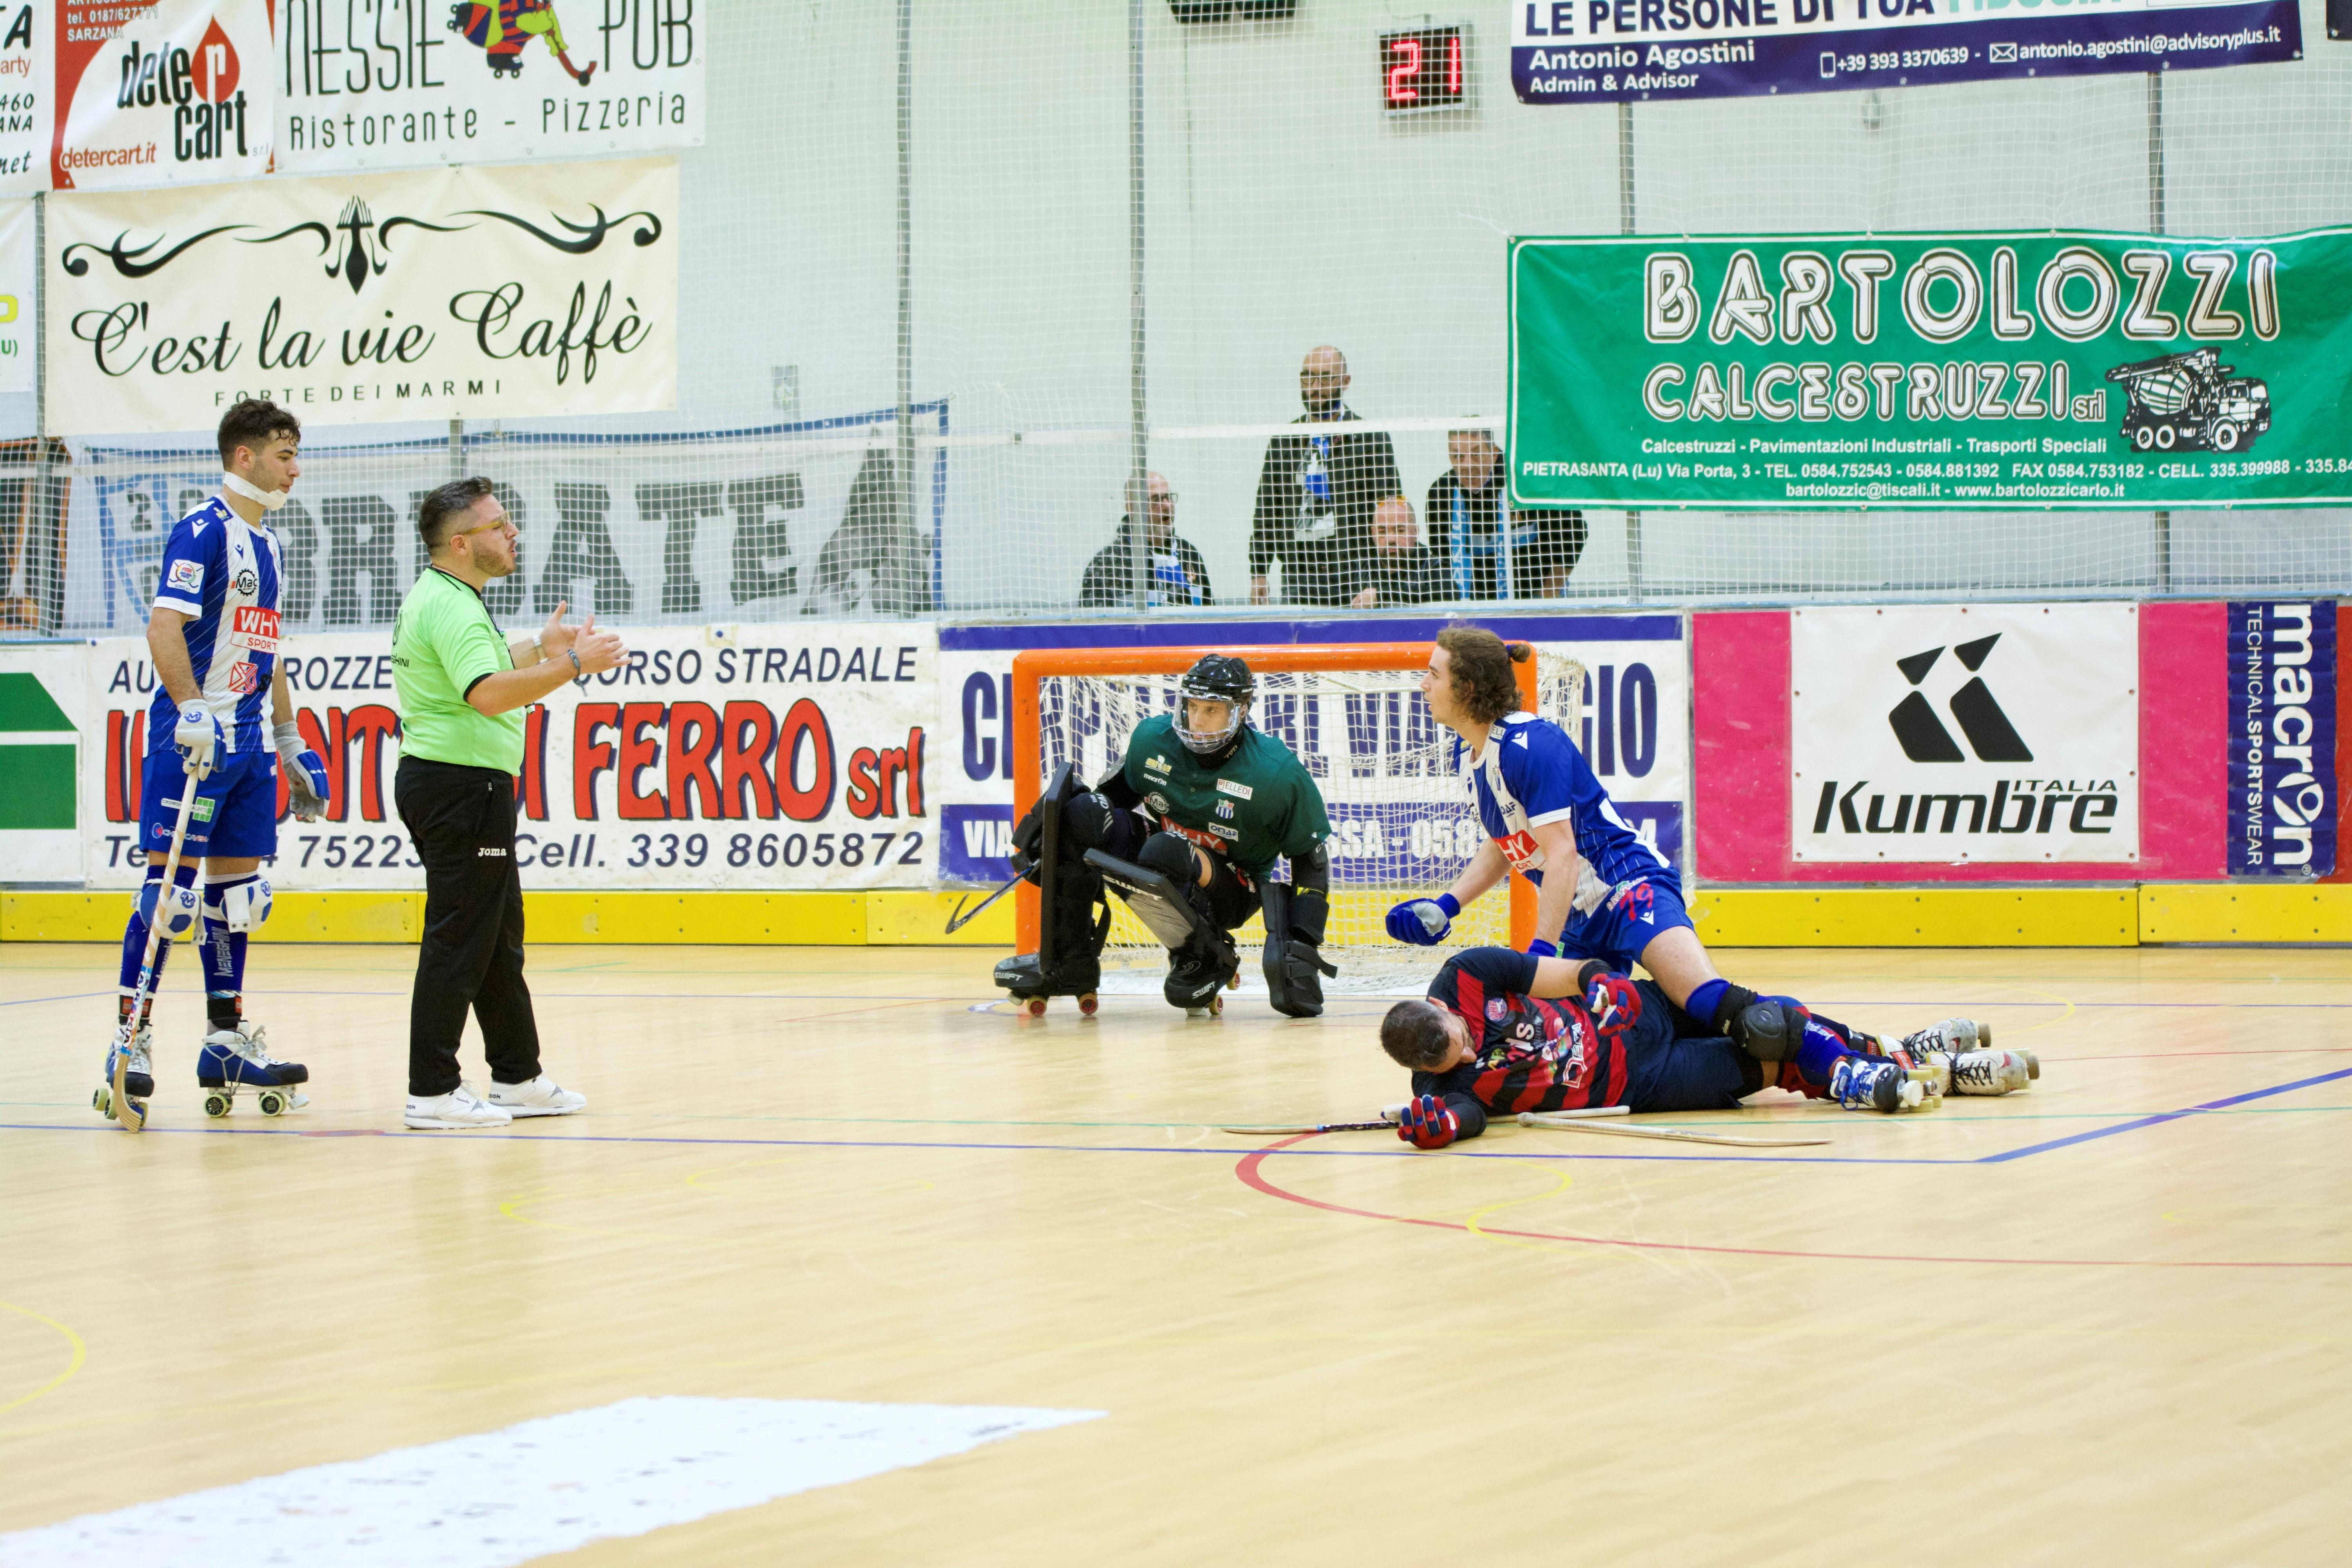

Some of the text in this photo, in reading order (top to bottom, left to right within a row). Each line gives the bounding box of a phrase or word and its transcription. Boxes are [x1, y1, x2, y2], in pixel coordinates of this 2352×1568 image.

[67, 5, 158, 24] tel. 0187/627771
[1526, 2, 1573, 36] LE
[1589, 0, 1777, 34] PERSONE
[67, 26, 123, 42] SARZANA
[1529, 47, 1639, 70] Antonio
[1645, 40, 1756, 70] Agostini
[1837, 55, 1866, 72] +39
[1869, 53, 1900, 70] 393
[1902, 47, 1969, 68] 3370639
[2019, 26, 2281, 60] antonio.agostini@advisoryplus.it
[1391, 38, 1459, 100] 21
[1530, 71, 1699, 94] Admin & Advisor
[175, 90, 248, 162] cart
[290, 106, 477, 150] Ristorante
[543, 91, 686, 134] Pizzeria
[61, 142, 156, 169] detercart.it
[1644, 245, 2281, 345] BARTOLOZZI
[71, 279, 653, 386] C'est la vie Caffè
[1642, 359, 2106, 423] CALCESTRUZZI srl
[1641, 438, 1736, 454] Calcestruzzi
[1749, 437, 1868, 454] Pavimentazioni
[1872, 437, 1951, 454] Industriali
[1967, 437, 2040, 457] Trasporti
[2042, 437, 2107, 457] Speciali
[1523, 462, 1629, 479] PIETRASANTA
[1632, 463, 1662, 480] (Lu)
[1666, 464, 1691, 478] Via
[1694, 464, 1737, 481] Porta,
[1742, 464, 1751, 478] 3
[1764, 464, 1797, 478] TEL.
[1800, 464, 1893, 478] 0584.752543
[1906, 463, 1999, 478] 0584.881392
[2013, 464, 2043, 478] FAX
[2047, 463, 2144, 479] 0584.753182
[2158, 463, 2205, 479] CELL.
[2210, 459, 2290, 477] 335.399988
[1786, 482, 1940, 500] bartolozzic@tiscali.it
[1954, 482, 2125, 498] www.bartolozzicarlo.it
[236, 577, 258, 588] Mac
[248, 637, 278, 650] SPORT
[715, 646, 918, 684] STRADALE
[2273, 604, 2324, 865] macron
[574, 697, 838, 823] FERRO
[846, 726, 926, 821] srl
[1144, 773, 1167, 786] macron
[1225, 782, 1250, 796] ELLEDI
[2014, 780, 2118, 792] ITALIA
[1813, 780, 2118, 834] Kumbre
[478, 847, 507, 857] Joma
[515, 834, 607, 868] Cell.
[628, 833, 709, 868] 339
[727, 831, 924, 868] 8605872
[963, 821, 1014, 858] VIA
